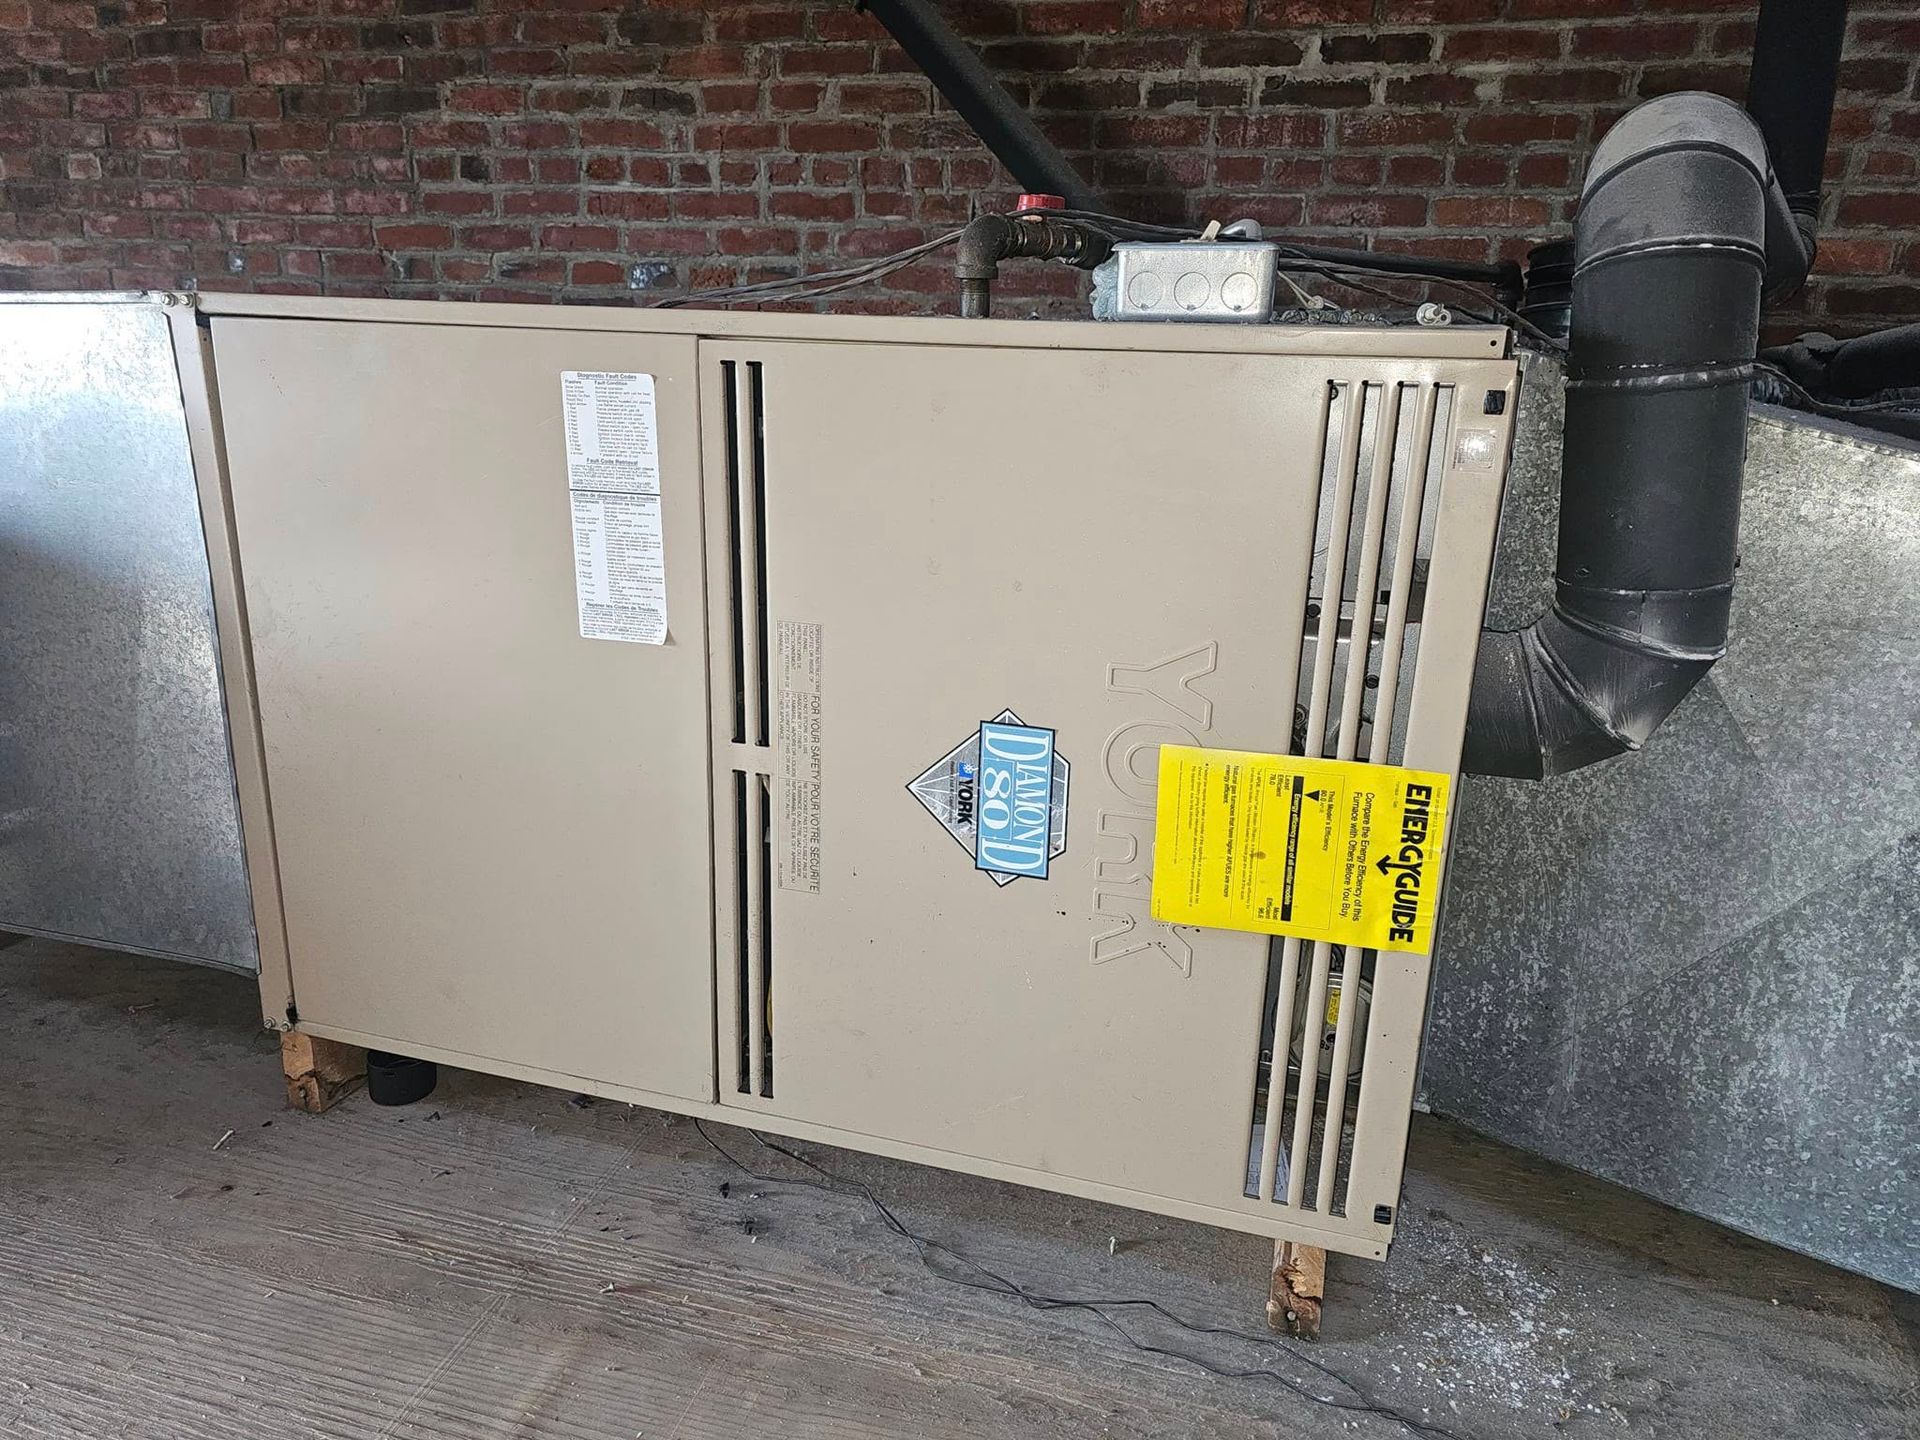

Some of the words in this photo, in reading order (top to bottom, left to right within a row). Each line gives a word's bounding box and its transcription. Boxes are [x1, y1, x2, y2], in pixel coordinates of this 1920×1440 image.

[810, 695, 819, 714] FOR
[810, 717, 819, 743] YOUR
[810, 745, 819, 780] SAFETY
[810, 784, 818, 810] POUR
[957, 778, 974, 825] YORK
[981, 729, 1050, 870] DIAMOND
[982, 767, 1011, 830] 80
[1290, 793, 1300, 813] Energy
[1350, 791, 1362, 821] Furnace
[1360, 792, 1375, 825] Compare
[810, 812, 818, 843] VOTRE
[1288, 813, 1298, 837] efficiency
[1348, 822, 1359, 839] with
[1360, 826, 1371, 838] the
[1287, 838, 1296, 852] range
[1321, 826, 1331, 851] Efficiency
[1346, 839, 1357, 862] Others
[1356, 839, 1369, 864] Energy
[1388, 783, 1432, 943] ENERGYGUIDE
[1343, 863, 1354, 885] Before
[1352, 864, 1367, 897] Efficiency
[1284, 884, 1292, 905] models
[1342, 886, 1352, 899] You
[1353, 899, 1363, 907] of
[1338, 903, 1350, 919] Buy.
[1351, 907, 1362, 922] this
